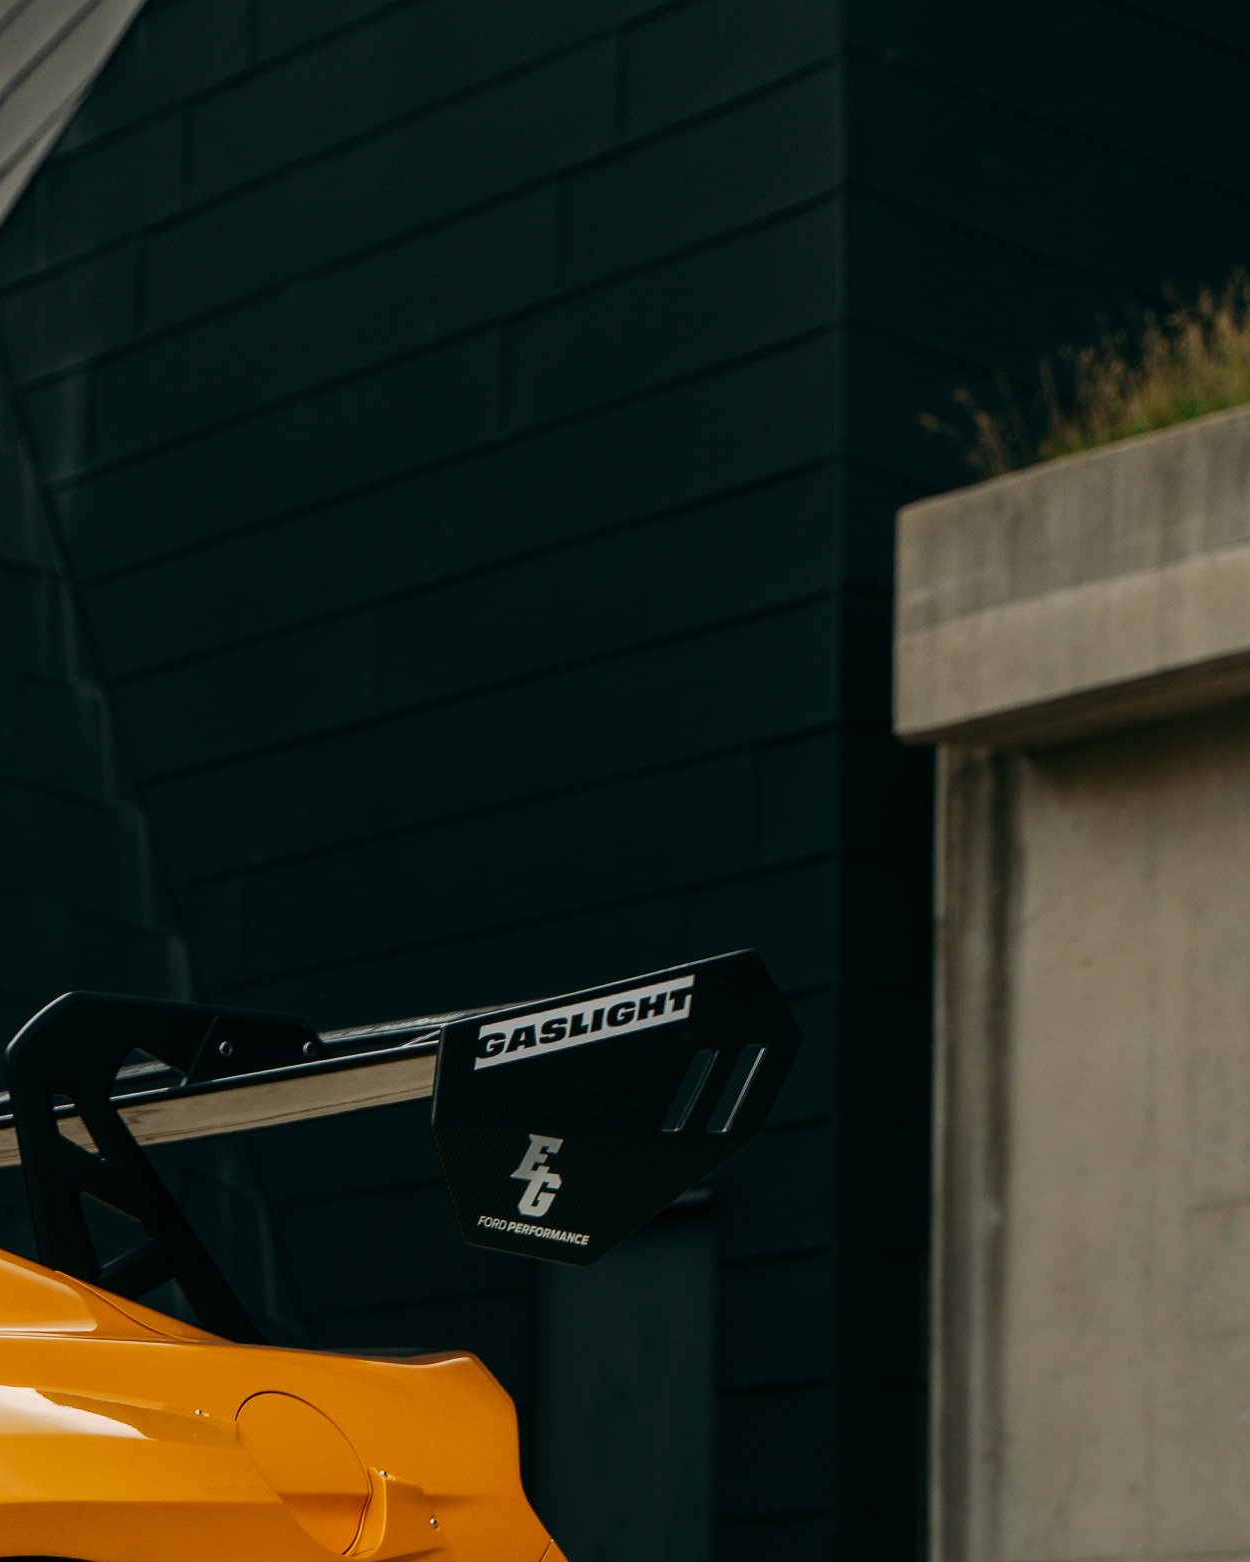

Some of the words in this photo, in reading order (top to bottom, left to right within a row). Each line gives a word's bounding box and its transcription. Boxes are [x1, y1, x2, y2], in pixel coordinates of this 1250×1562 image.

[477, 985, 694, 1060] GASLIGHT
[477, 1215, 507, 1230] FORD
[507, 1221, 590, 1245] PERFORMANCE
